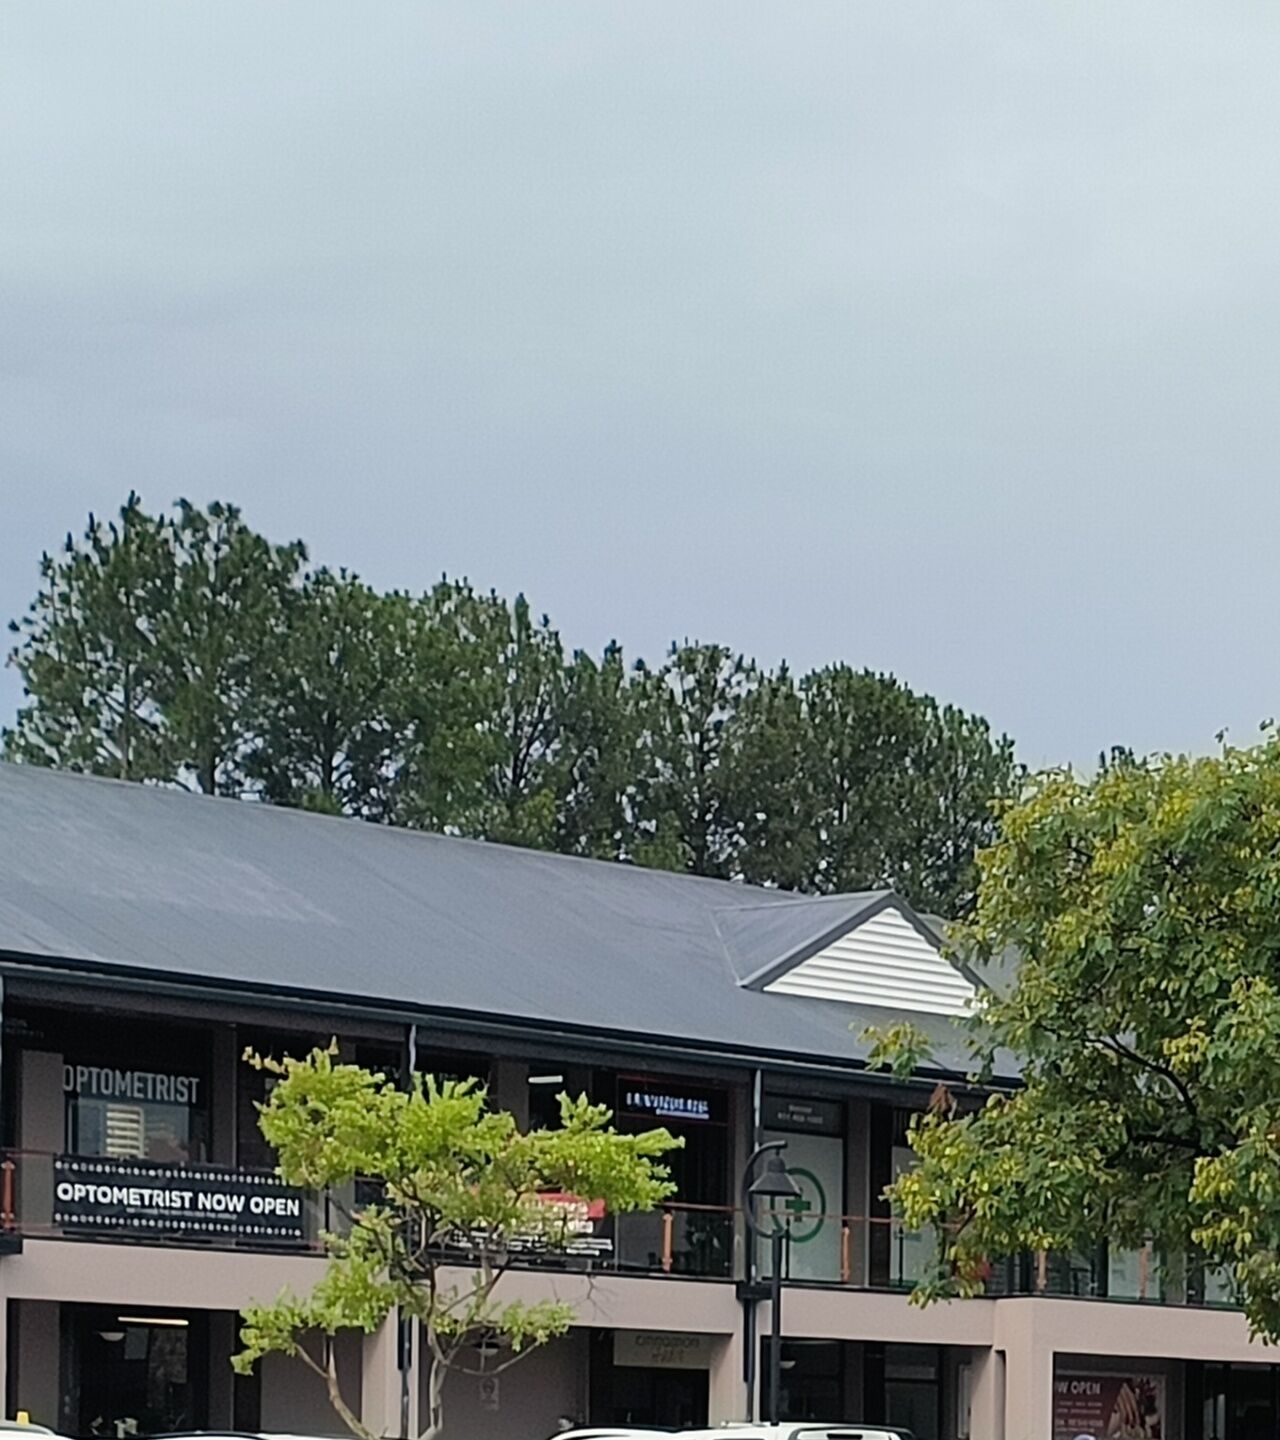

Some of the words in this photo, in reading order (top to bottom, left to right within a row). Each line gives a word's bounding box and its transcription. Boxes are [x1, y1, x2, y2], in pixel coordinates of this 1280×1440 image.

[63, 1064, 199, 1103] OPTOMETRIST
[56, 1182, 192, 1209] OPTOMETRIST
[198, 1192, 245, 1213] NOW
[250, 1195, 300, 1216] OPEN
[1071, 1382, 1101, 1395] OPEN
